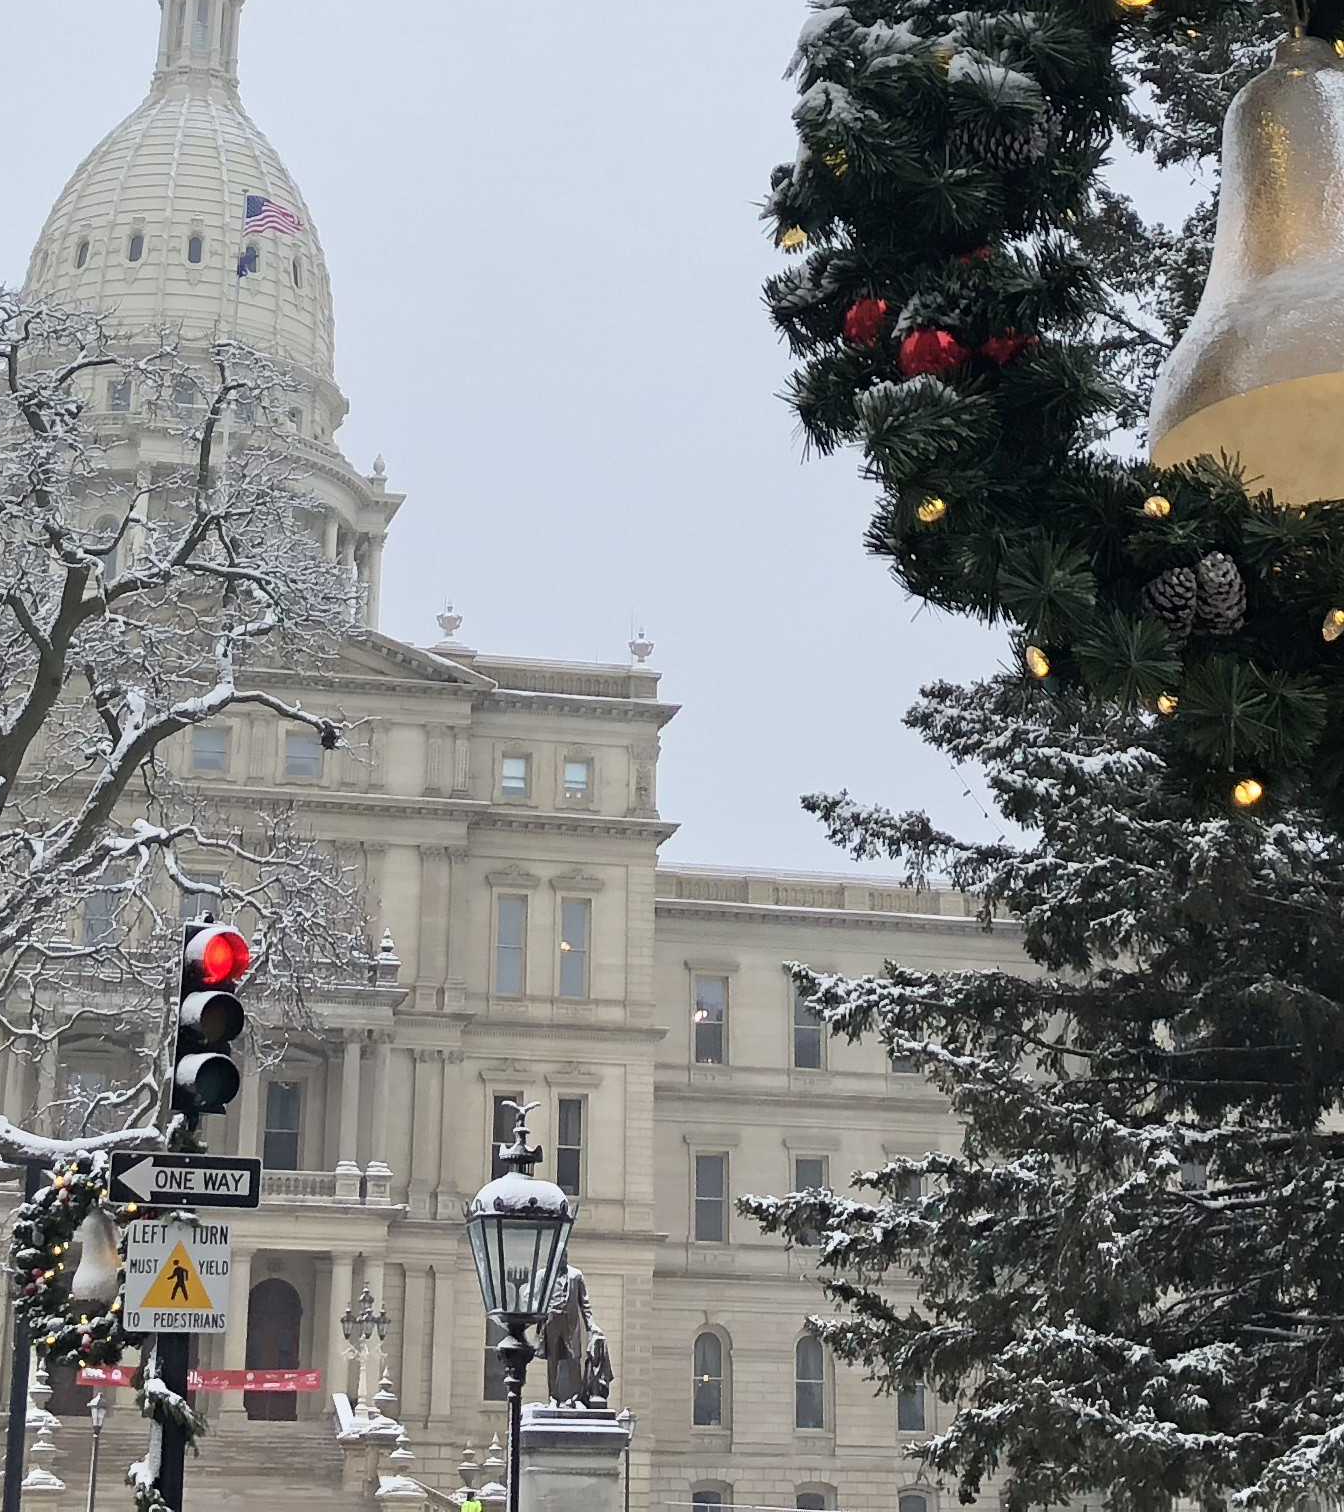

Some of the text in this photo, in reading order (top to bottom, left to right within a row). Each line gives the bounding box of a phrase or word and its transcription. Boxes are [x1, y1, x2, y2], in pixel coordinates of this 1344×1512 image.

[155, 1170, 244, 1192] ONE WAY
[132, 1224, 229, 1245] LEFT TURN
[129, 1259, 229, 1275] MUST YIELD
[127, 1312, 226, 1329] TO PEDESTRIANS
